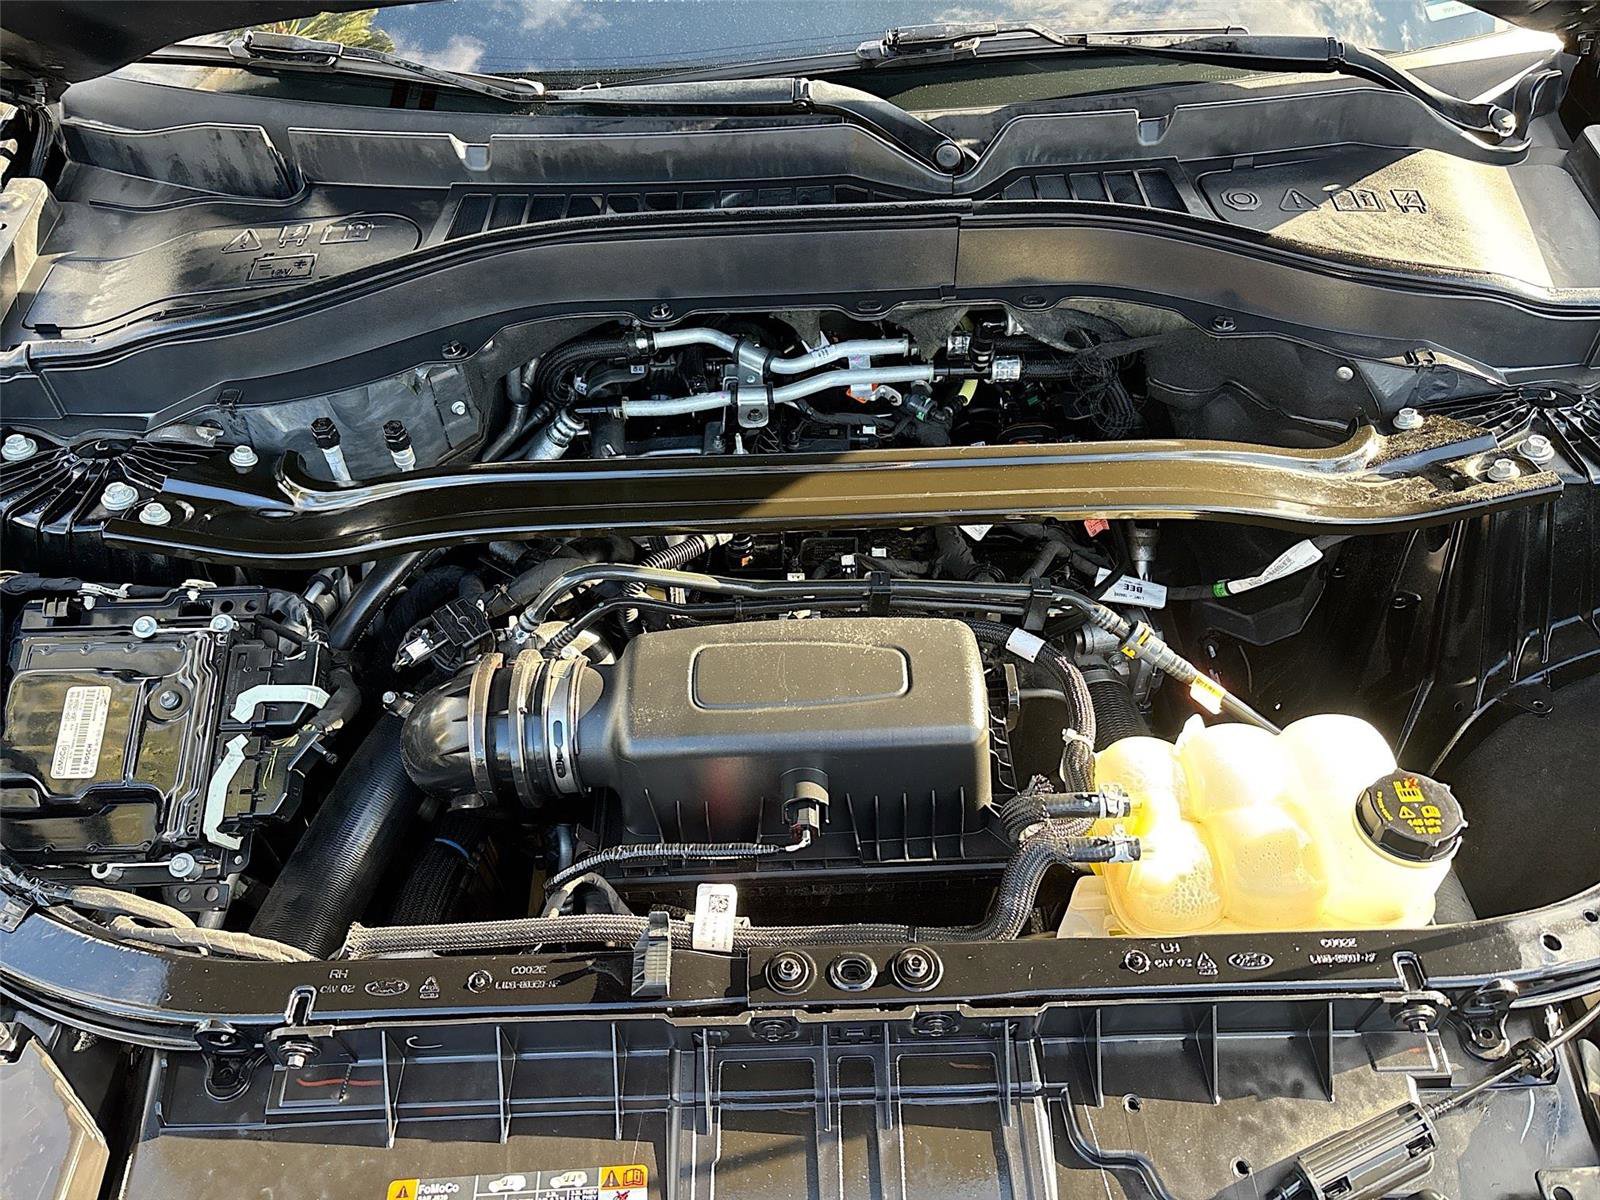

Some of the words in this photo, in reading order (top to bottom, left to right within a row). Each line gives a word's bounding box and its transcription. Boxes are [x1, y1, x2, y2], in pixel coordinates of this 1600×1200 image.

[83, 743, 93, 764] BOSCH
[329, 969, 349, 979] RH
[418, 1182, 460, 1195] FoMoCo
